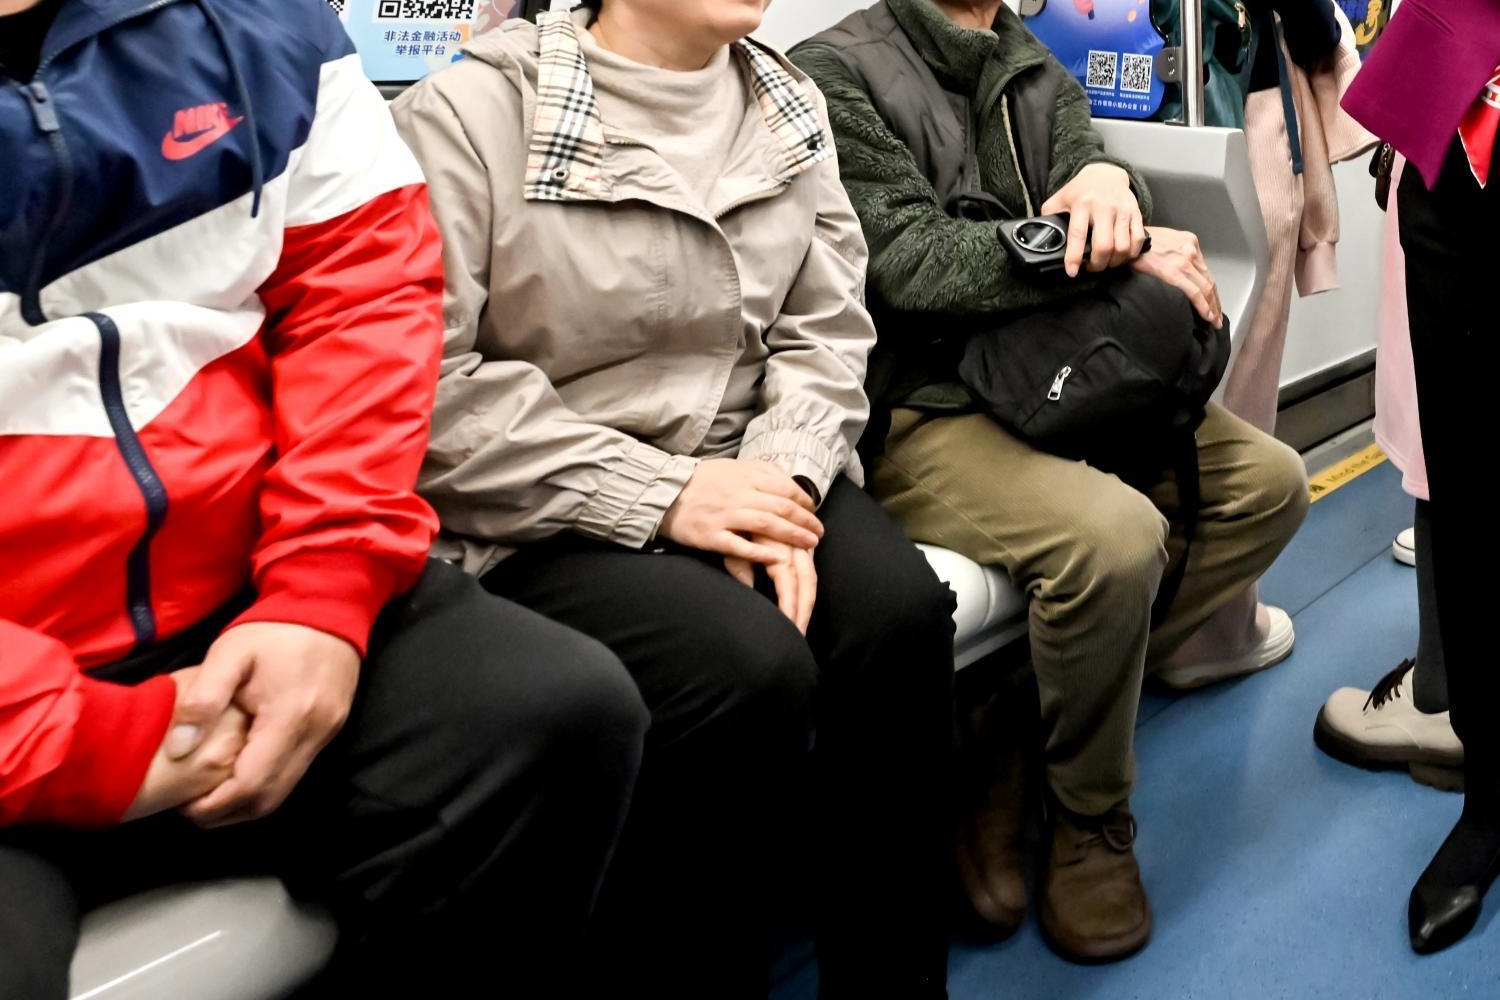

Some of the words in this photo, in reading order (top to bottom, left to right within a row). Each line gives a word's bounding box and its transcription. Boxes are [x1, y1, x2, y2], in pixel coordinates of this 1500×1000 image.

[384, 29, 462, 42] 非法金融活动
[395, 44, 446, 56] 举报平台
